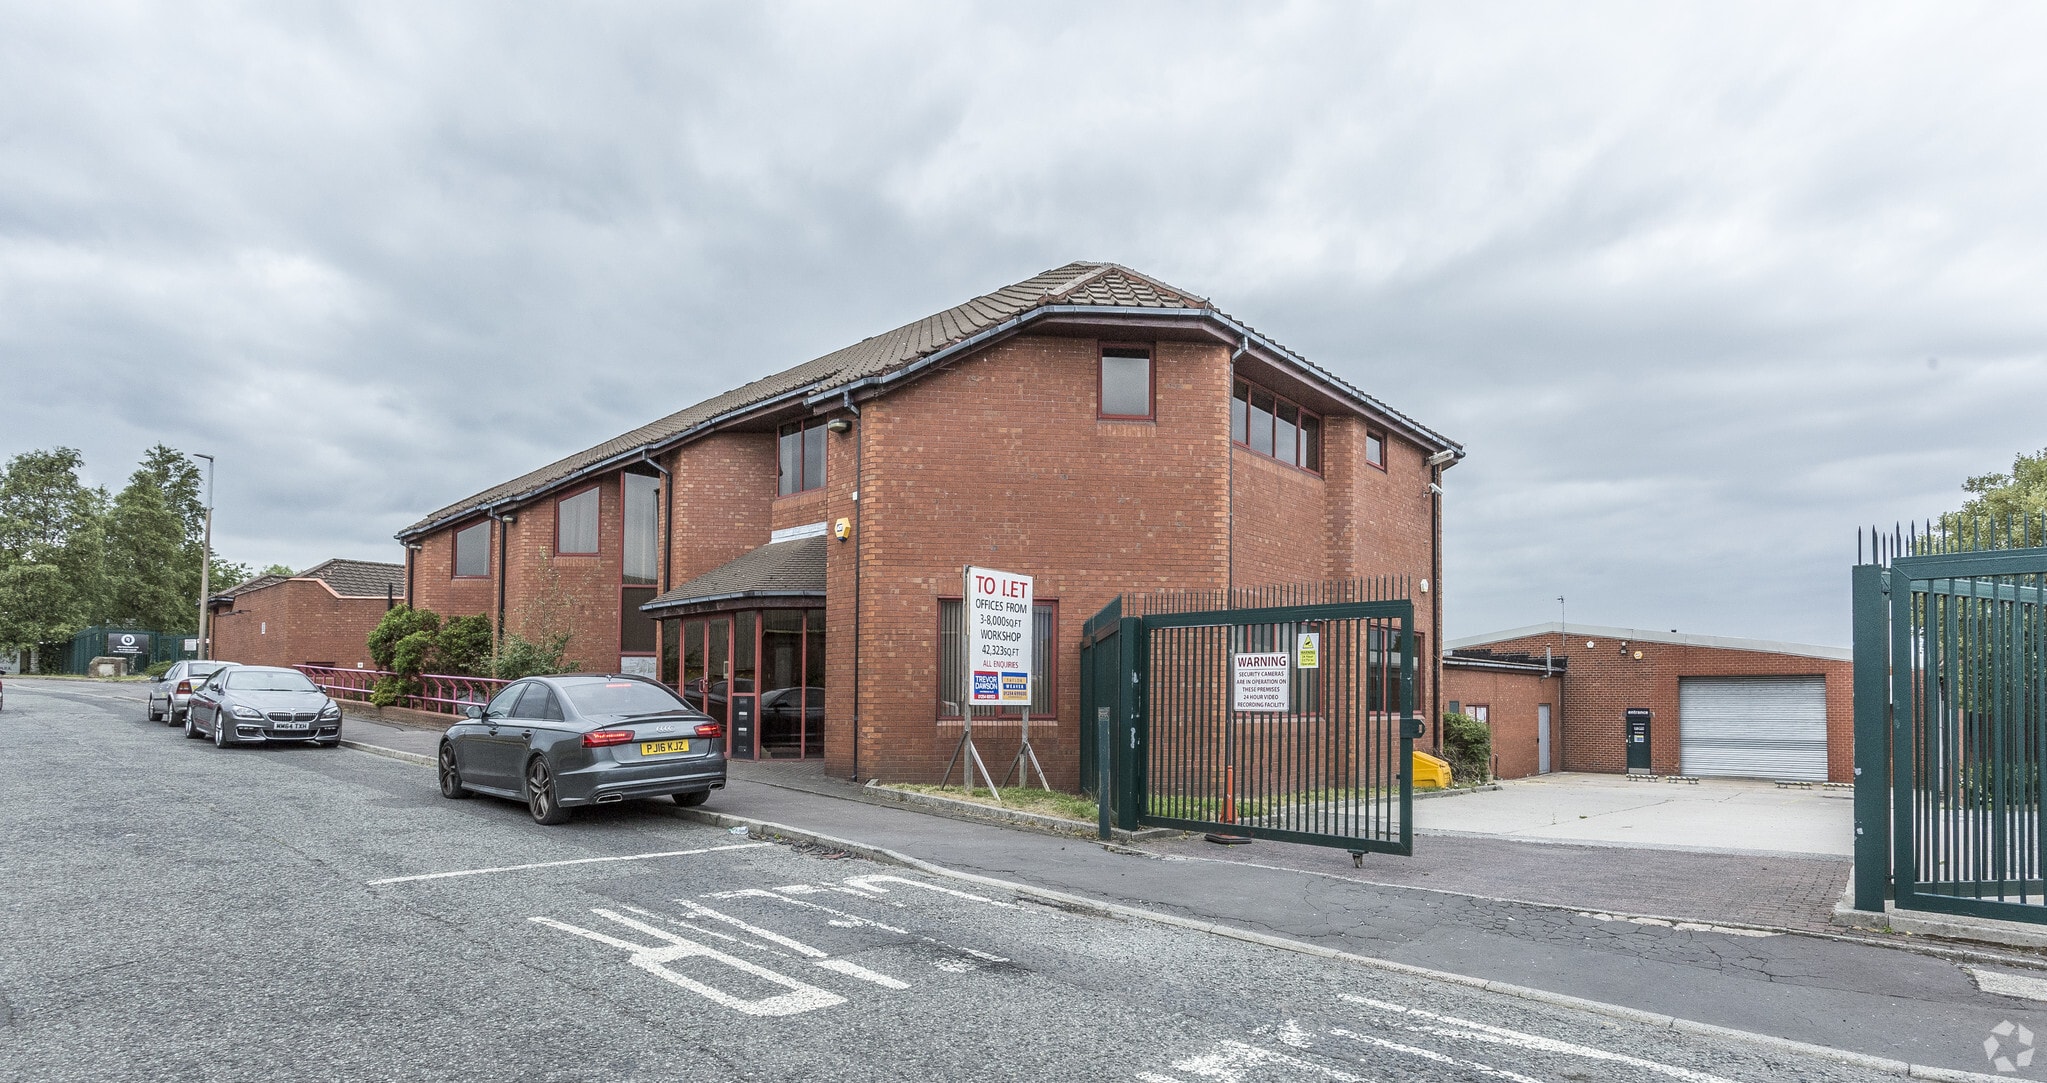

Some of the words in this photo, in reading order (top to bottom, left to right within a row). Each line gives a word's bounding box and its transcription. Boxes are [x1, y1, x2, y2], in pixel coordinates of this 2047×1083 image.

[976, 575, 996, 595] TO
[976, 598, 1004, 612] OFFICES
[1006, 602, 1027, 614] FROM
[980, 629, 1021, 642] WORKSHOP
[994, 660, 1018, 668] ENQUIRIES
[1238, 656, 1286, 667] WARNING
[646, 743, 666, 753] PJ16
[668, 741, 684, 751] KJZ
